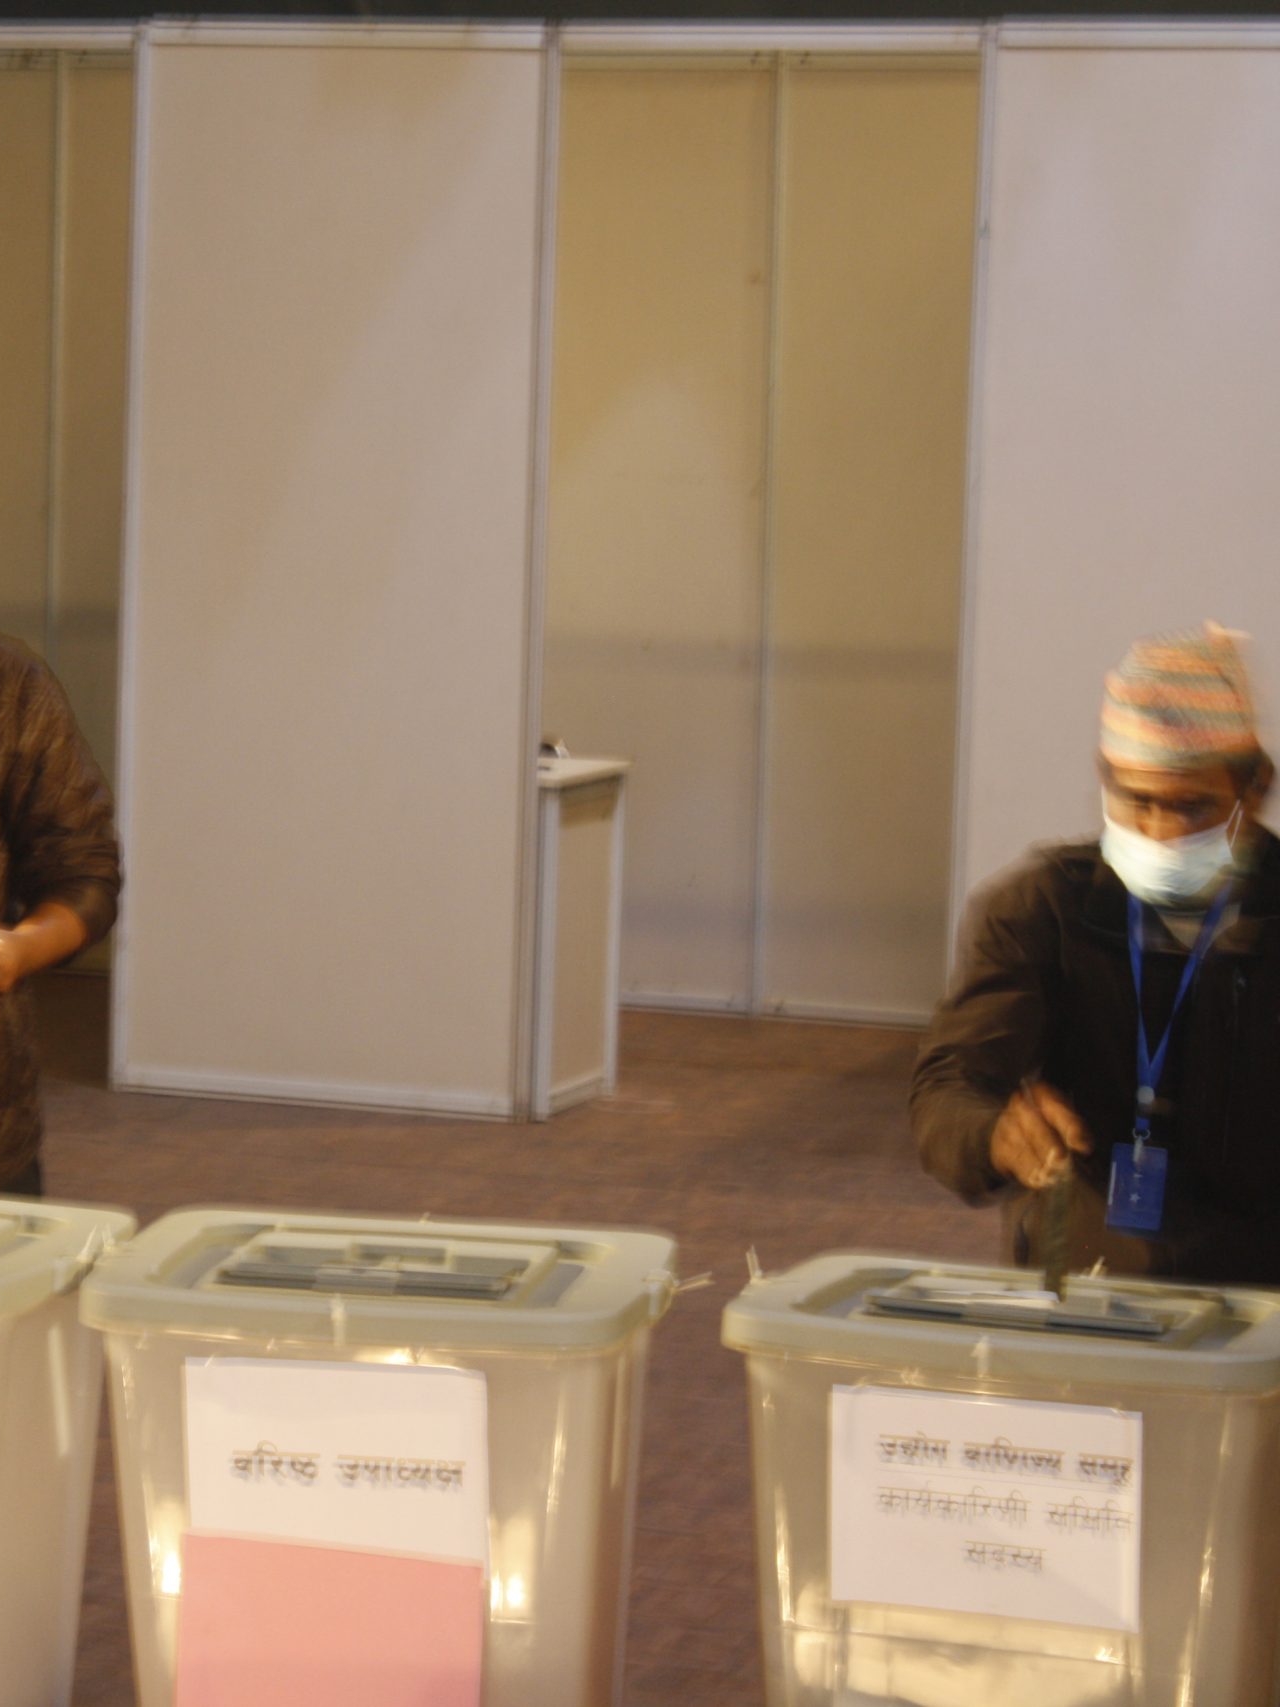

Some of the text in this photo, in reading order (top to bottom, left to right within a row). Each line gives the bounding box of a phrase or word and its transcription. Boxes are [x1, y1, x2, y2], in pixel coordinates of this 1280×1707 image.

[230, 1439, 466, 1493] वरिष्ठ उपाध्यक्ष
[876, 1480, 1134, 1538] कार्यकारिणी समिति
